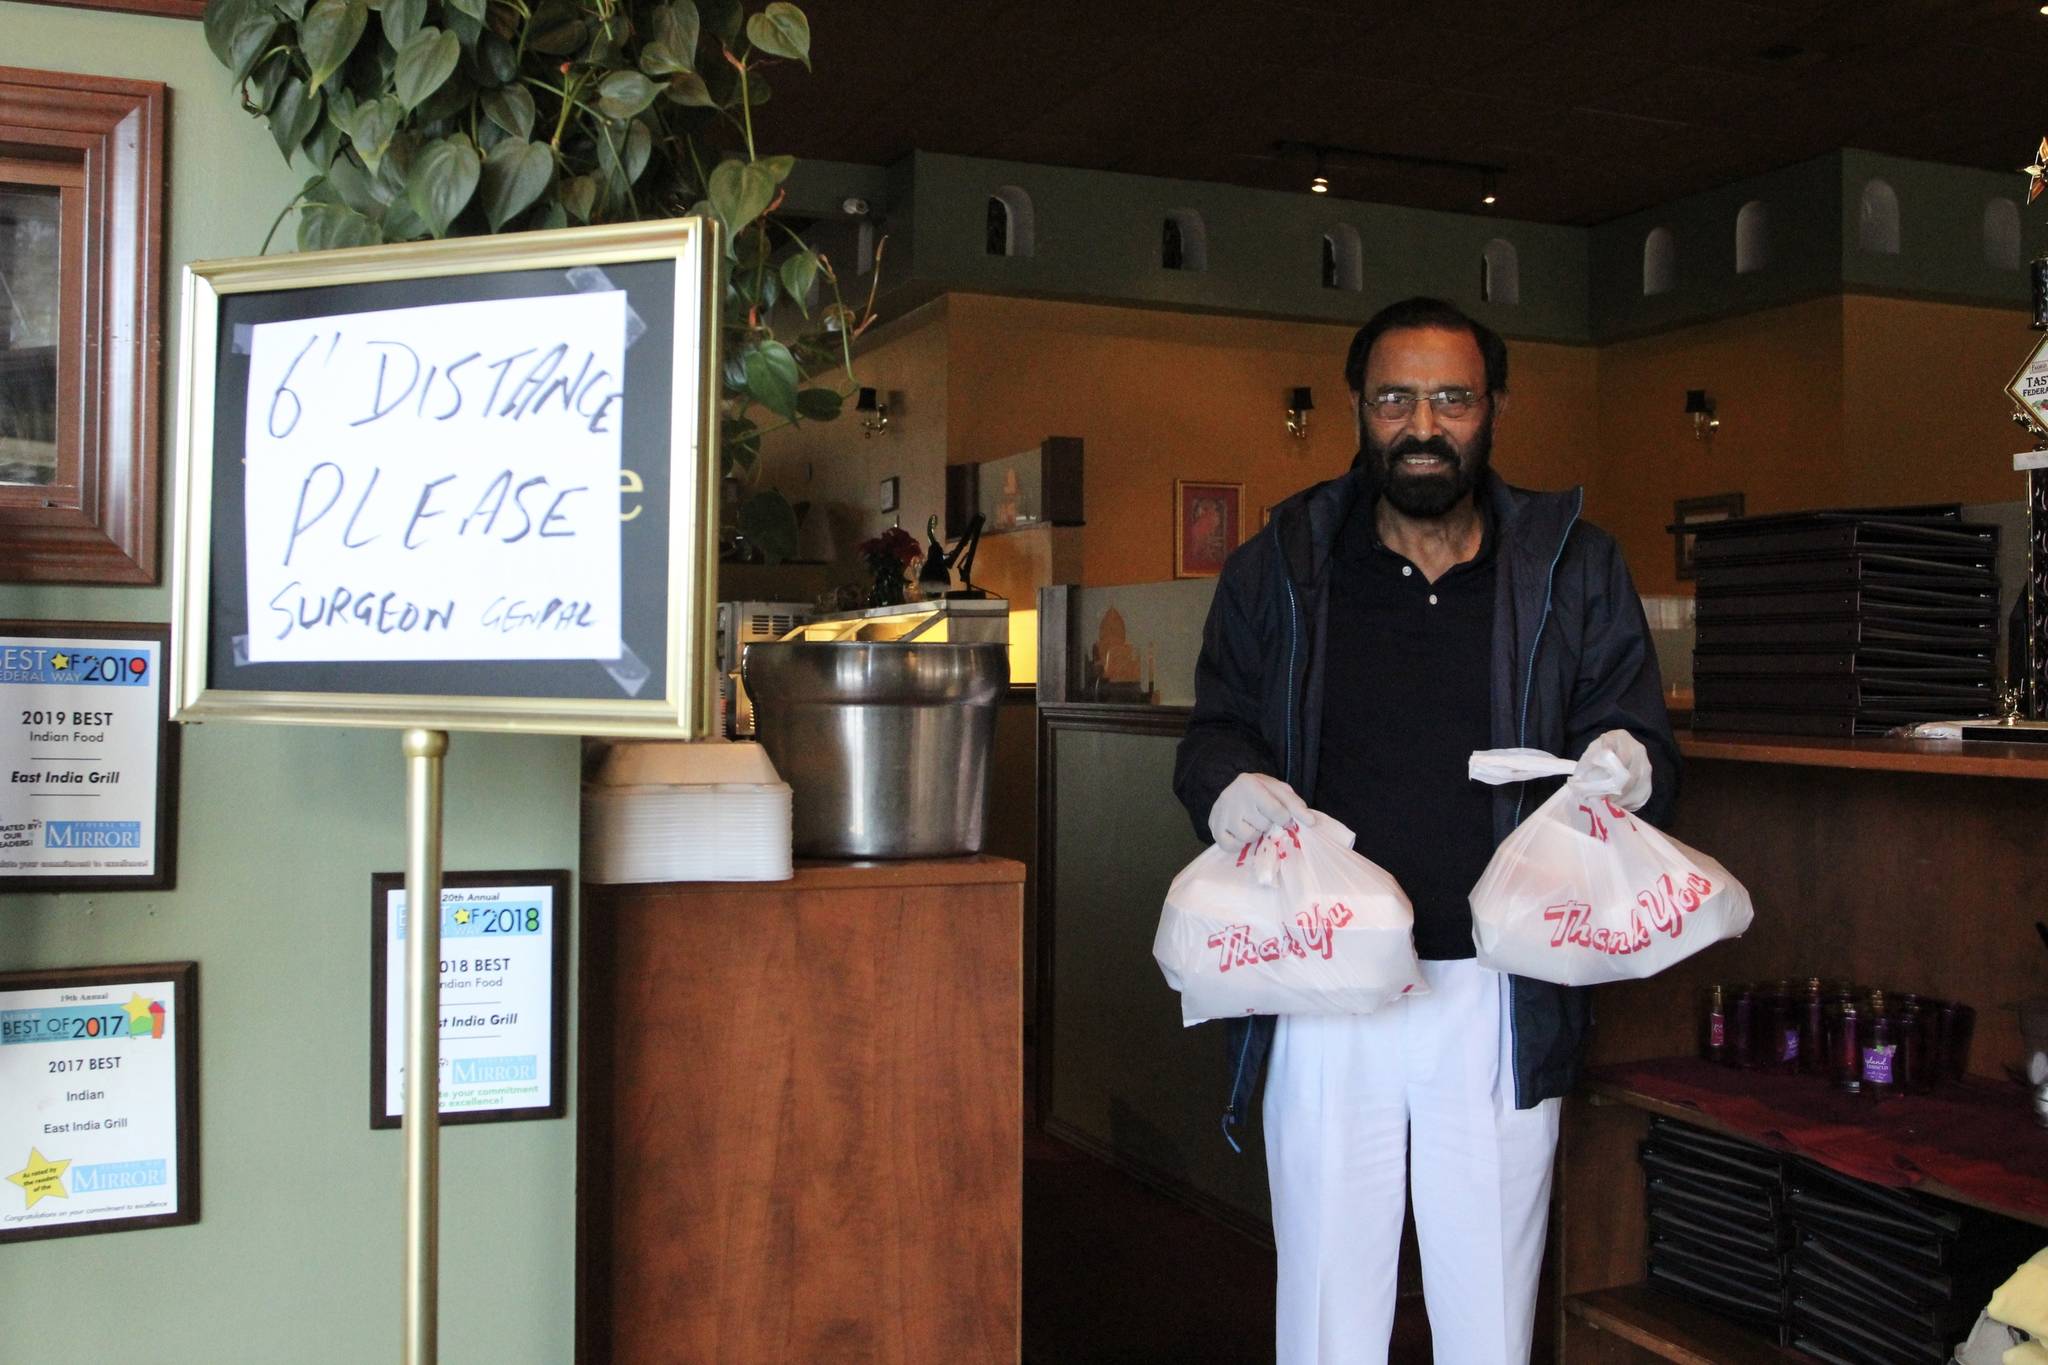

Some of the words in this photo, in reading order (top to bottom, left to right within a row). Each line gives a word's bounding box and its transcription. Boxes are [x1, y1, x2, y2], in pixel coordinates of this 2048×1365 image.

[349, 340, 624, 433] DISTANCE
[2026, 376, 2048, 388] TAS
[283, 461, 588, 566] PLEASE
[269, 581, 455, 640] SURGEON
[82, 655, 148, 683] 2019
[22, 711, 66, 726] 2019
[72, 712, 113, 726] BEST
[29, 731, 69, 743] Indian
[74, 732, 104, 743] Food
[11, 771, 42, 784] East
[46, 771, 84, 784] India
[88, 771, 120, 784] Grill
[47, 823, 133, 847] MIRROR
[442, 894, 464, 902] 20th
[467, 892, 500, 901] Annual
[482, 907, 540, 933] 2018
[1543, 900, 1651, 955] Thank
[1637, 872, 1713, 939] You
[439, 959, 468, 973] 018
[474, 958, 511, 972] BEST
[439, 979, 471, 988] ndian
[475, 977, 503, 987] Food
[3, 1019, 41, 1035] BEST
[47, 1018, 70, 1033] OF
[71, 1015, 124, 1038] 2017
[439, 1016, 448, 1028] st
[451, 1014, 486, 1027] India
[490, 1013, 518, 1025] Grill
[48, 1059, 84, 1073] 2017
[89, 1056, 123, 1071] BEST
[454, 1062, 530, 1082] MIRROR
[66, 1089, 105, 1102] Indian
[44, 1122, 70, 1134] East
[73, 1119, 101, 1132] India
[104, 1117, 128, 1129] Grill
[74, 1166, 160, 1191] MIRROR
